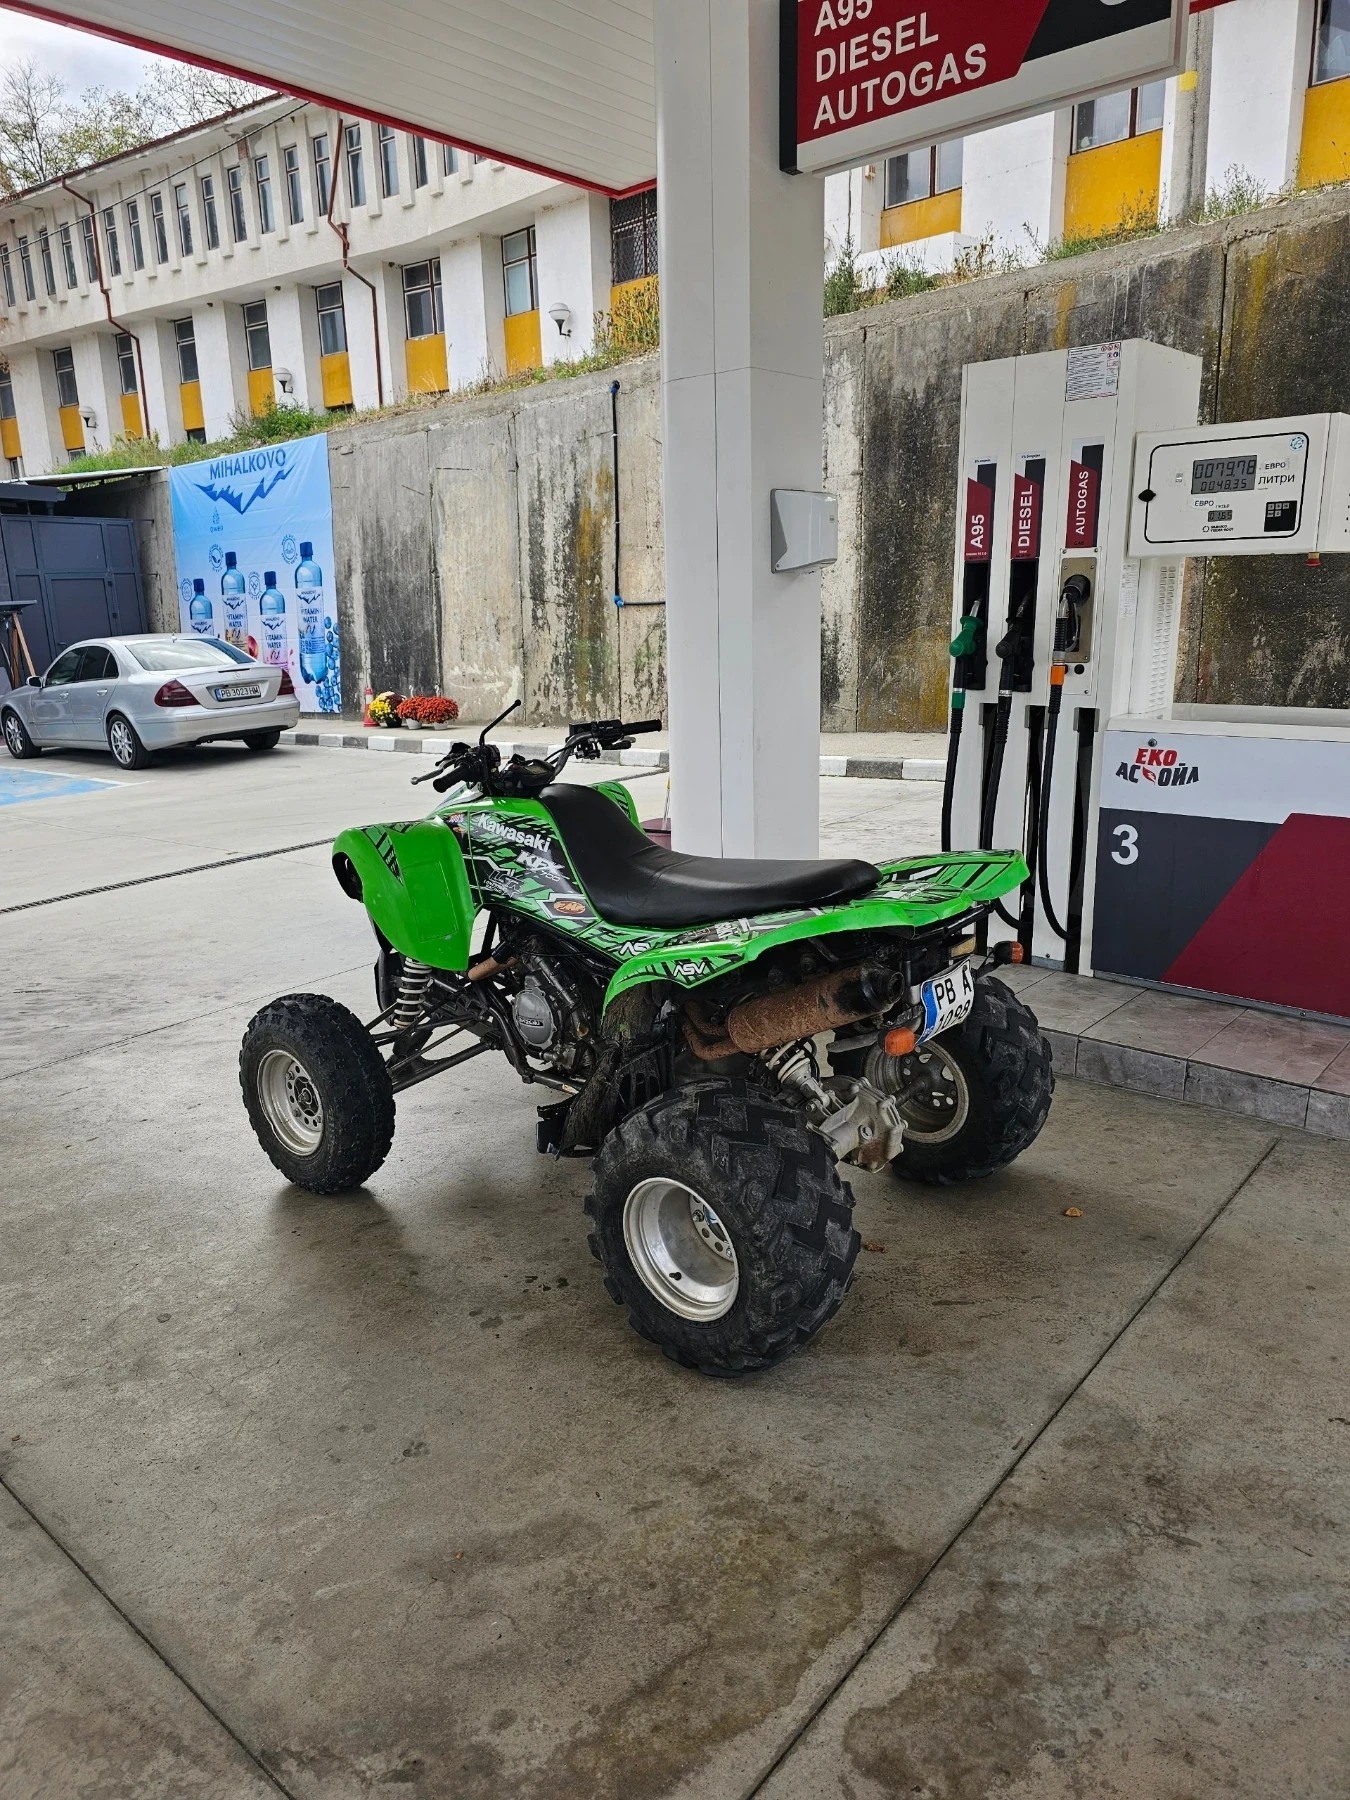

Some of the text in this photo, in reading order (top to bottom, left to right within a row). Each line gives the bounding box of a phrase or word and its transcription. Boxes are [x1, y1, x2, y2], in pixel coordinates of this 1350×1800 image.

[814, 0, 873, 37] A95
[816, 12, 939, 83] DIESEL
[813, 43, 987, 130] AUTOGAS
[209, 448, 286, 480] MIHALKOVO
[1258, 474, 1295, 485] литри
[1265, 462, 1286, 470] ЕВРО
[1018, 485, 1033, 547] DIESEL
[1075, 471, 1089, 535] AUTOGAS
[971, 514, 985, 549] A95
[302, 615, 318, 624] WATER
[232, 687, 249, 696] 3023
[477, 812, 552, 853] Kawasaki
[1111, 824, 1139, 865] 3
[619, 941, 651, 956] AS
[673, 962, 706, 977] ASV
[934, 965, 972, 1010] PB A
